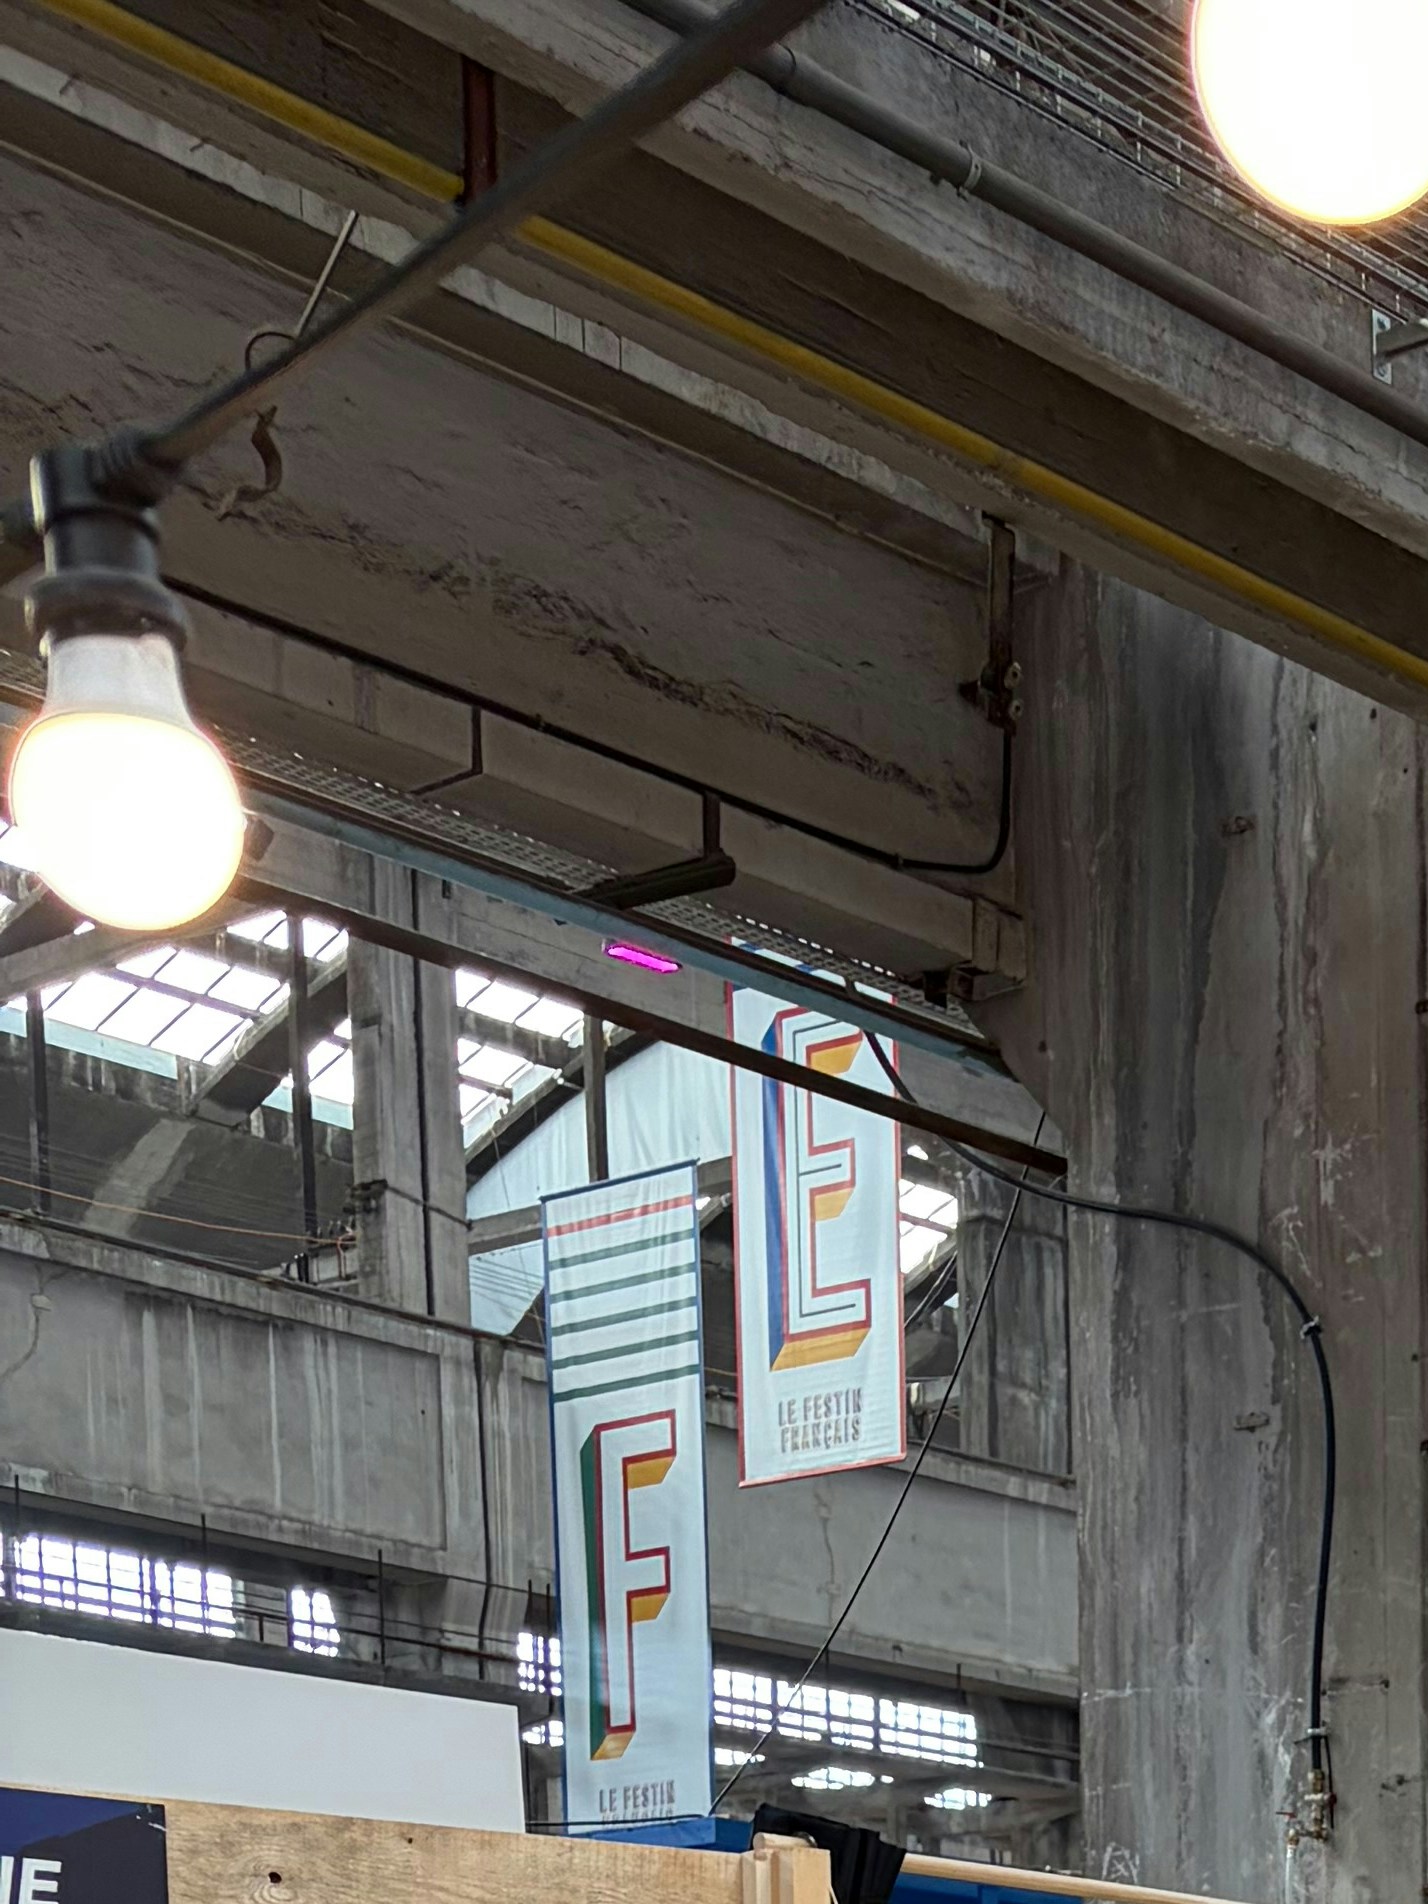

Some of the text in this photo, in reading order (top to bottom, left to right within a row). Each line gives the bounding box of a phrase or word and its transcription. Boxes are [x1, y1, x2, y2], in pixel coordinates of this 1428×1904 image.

[763, 1006, 872, 1371] E
[778, 1388, 862, 1427] LE FESTIN
[781, 1415, 861, 1453] FRANÇAIS
[581, 1409, 677, 1760] F
[599, 1780, 676, 1814] LE FESTIN
